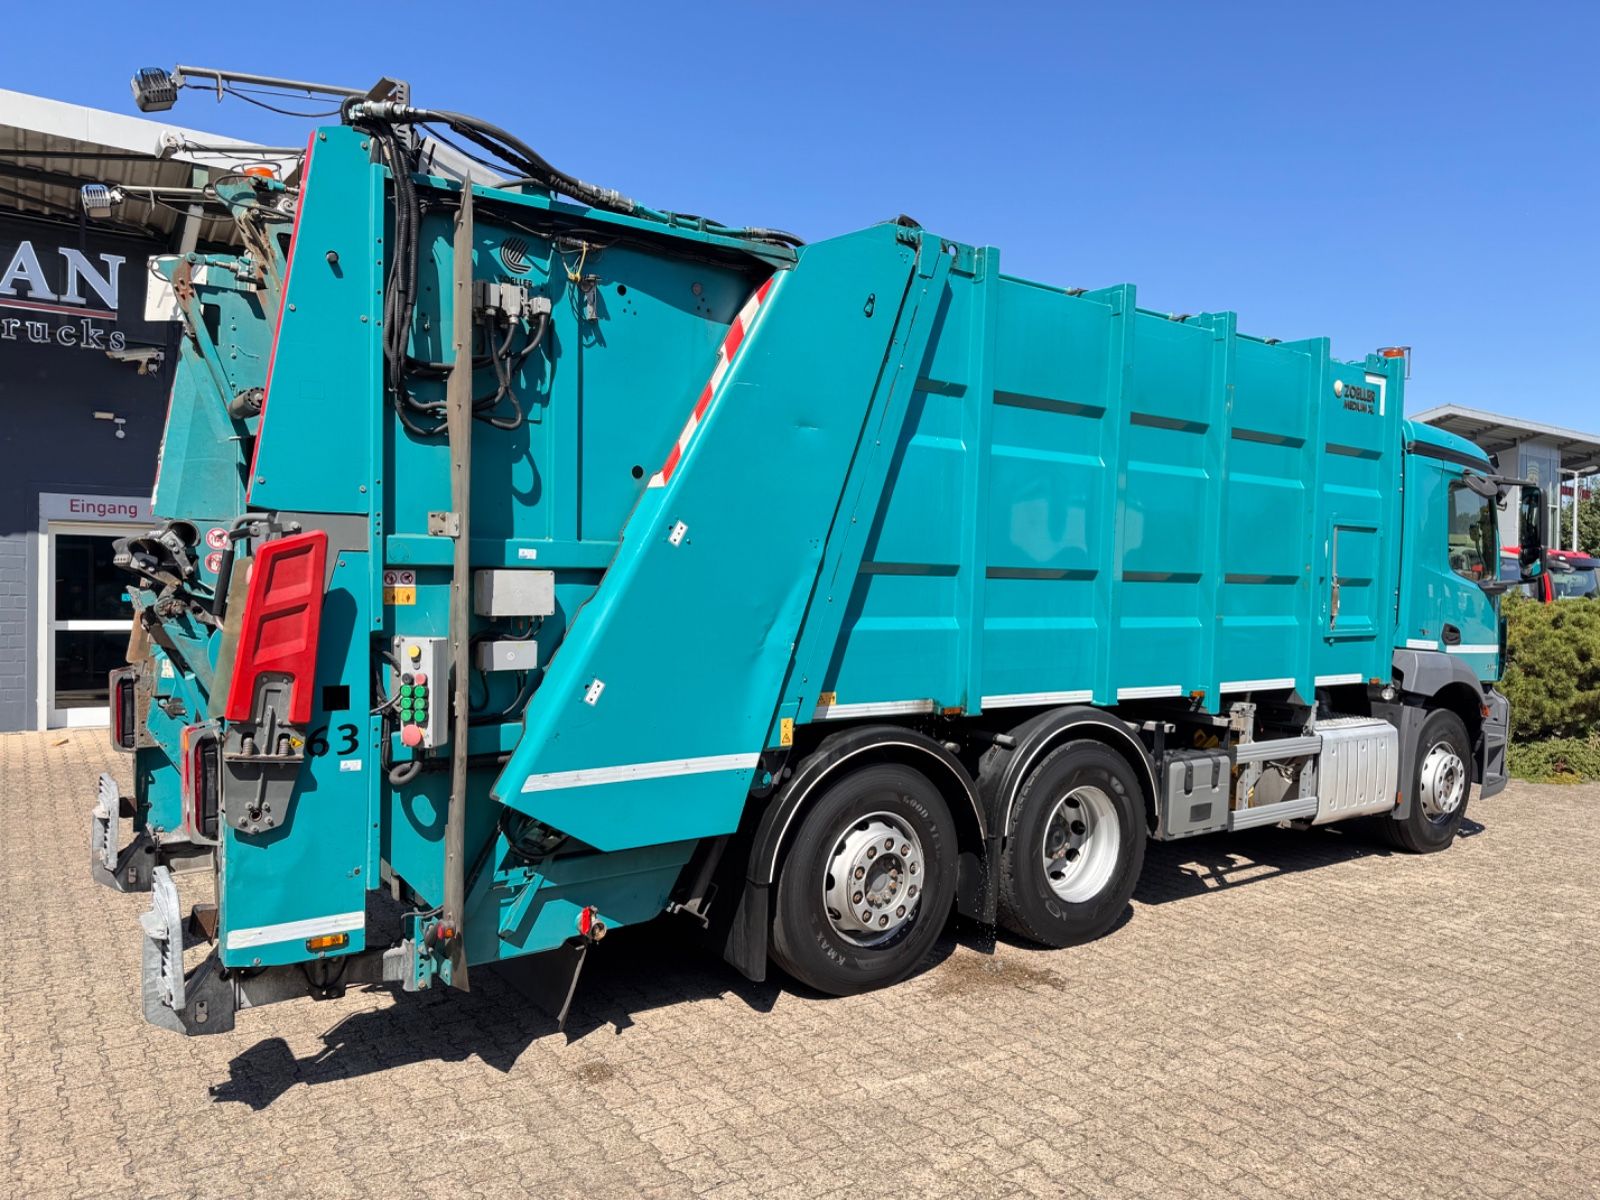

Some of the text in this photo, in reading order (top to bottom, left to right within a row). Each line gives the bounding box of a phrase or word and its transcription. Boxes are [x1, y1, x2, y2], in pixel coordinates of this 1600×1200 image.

[1344, 384, 1376, 403] ZOELLER
[70, 499, 138, 518] Eingang
[306, 724, 359, 757] 63
